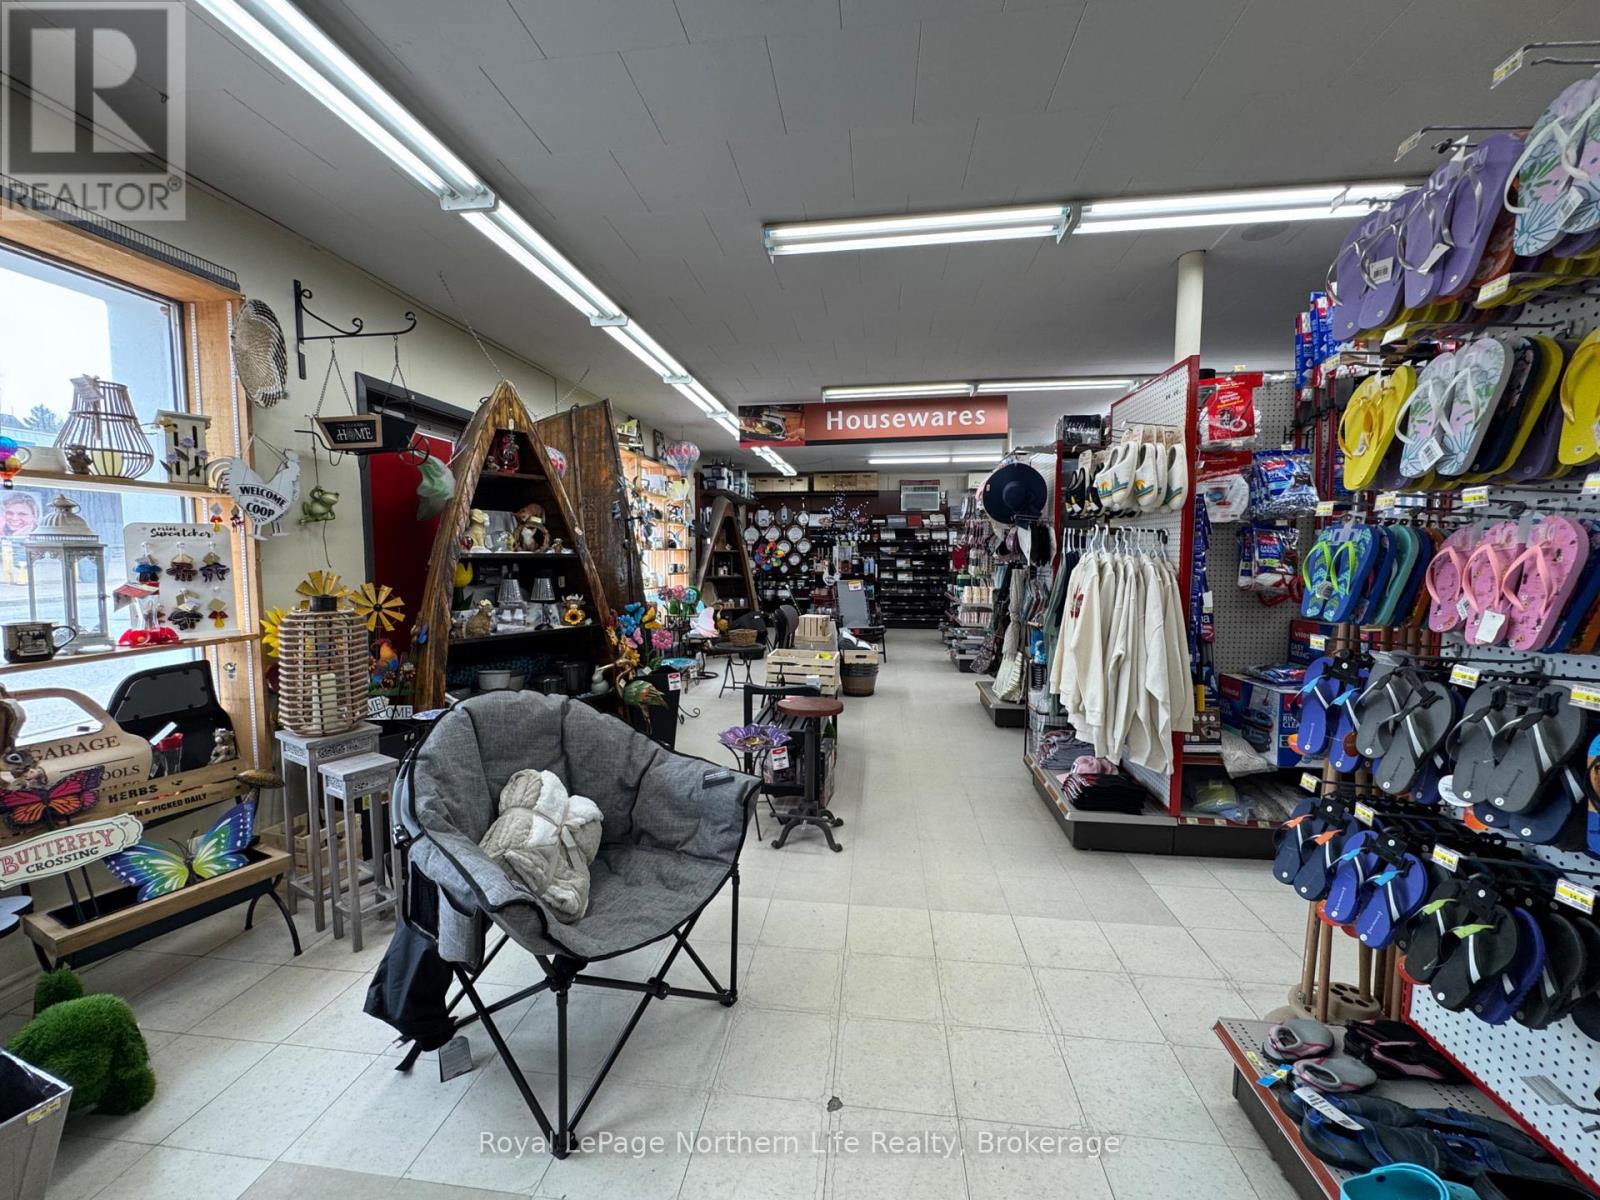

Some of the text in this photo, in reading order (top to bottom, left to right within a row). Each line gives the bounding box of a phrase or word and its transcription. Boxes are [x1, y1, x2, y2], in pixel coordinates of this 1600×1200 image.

[826, 408, 987, 431] Housewares
[239, 486, 287, 507] WELCOME
[246, 502, 275, 518] COOP
[32, 735, 120, 761] GARAGE
[100, 764, 141, 781] OOLS
[108, 784, 159, 803] HERBS
[152, 799, 183, 813] PICKED
[184, 793, 207, 804] DAILY
[1, 828, 115, 876] BUTTERFLY
[26, 846, 100, 874] CROSSING
